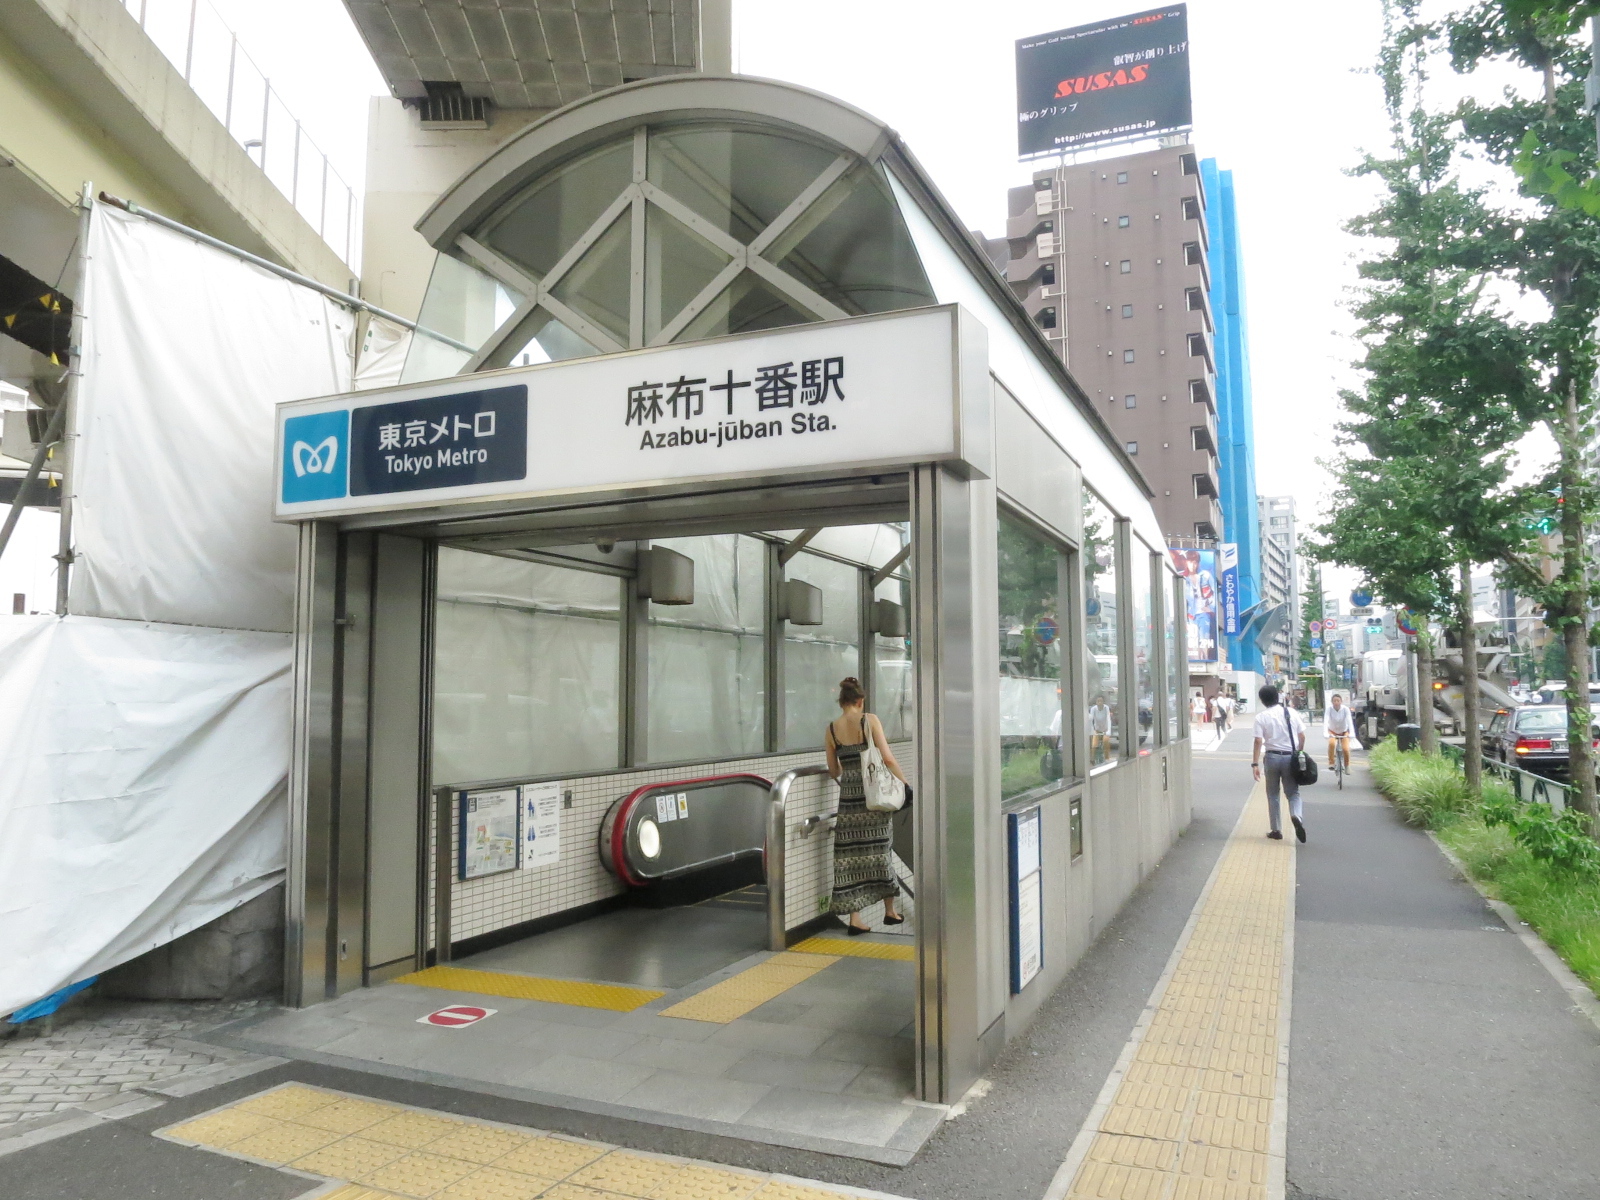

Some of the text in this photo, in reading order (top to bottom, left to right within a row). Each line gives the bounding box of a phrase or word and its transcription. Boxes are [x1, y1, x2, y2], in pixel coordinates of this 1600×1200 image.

[1054, 64, 1149, 98] SUSAS
[1054, 119, 1156, 145] http://www.susas.jp
[625, 356, 845, 427] 麻布十番駅
[378, 411, 496, 450] 東京メトロ
[639, 412, 837, 450] Azabu-jūban Sta.
[385, 448, 488, 475] Tokyo Metro
